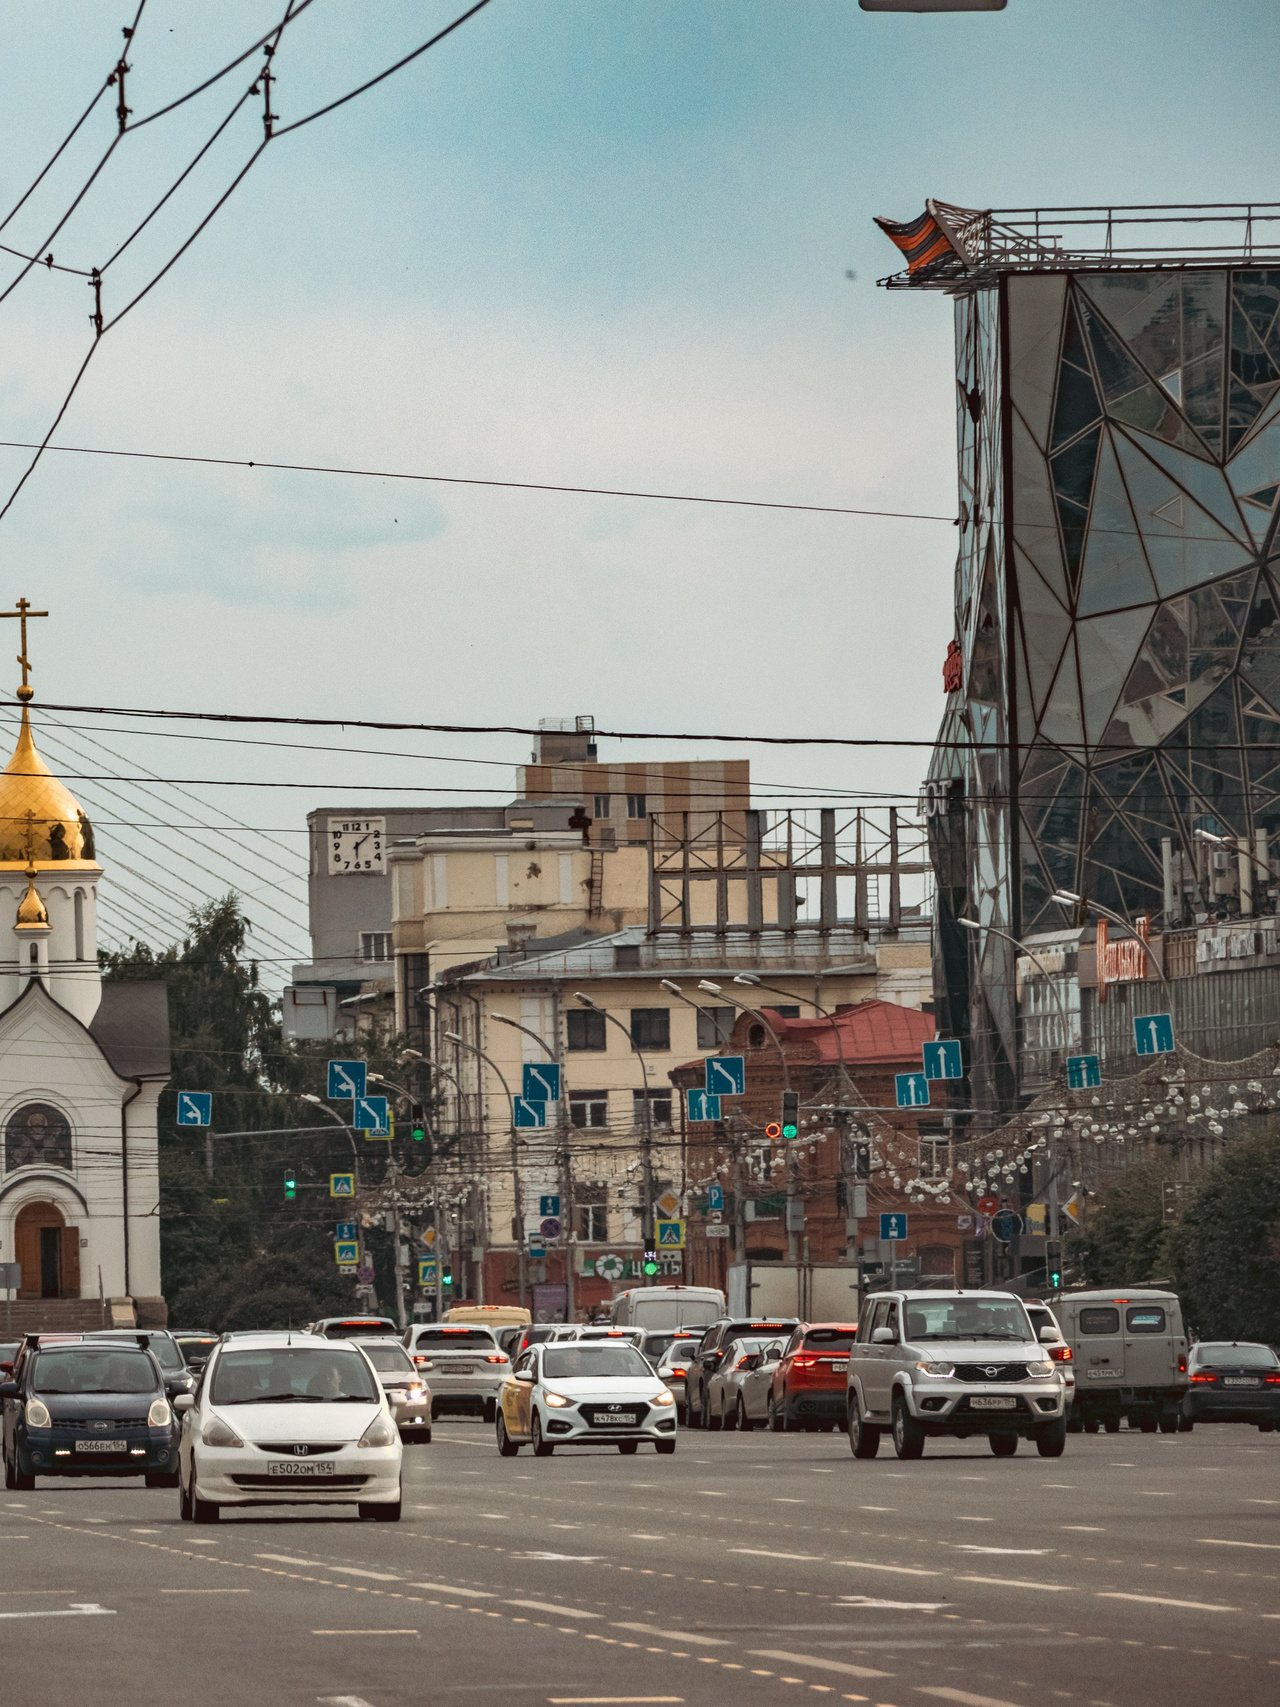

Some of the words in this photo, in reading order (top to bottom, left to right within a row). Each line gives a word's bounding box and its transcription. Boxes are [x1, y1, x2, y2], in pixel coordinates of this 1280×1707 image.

[342, 823, 349, 831] 11
[351, 823, 361, 831] 12
[365, 823, 369, 831] 1
[333, 830, 342, 839] 10
[373, 830, 380, 838] 2
[333, 842, 340, 850] 9
[373, 841, 380, 850] 3
[334, 853, 341, 862] 8
[374, 852, 381, 861] 4
[344, 861, 350, 870] 7
[354, 861, 361, 870] 6
[364, 860, 371, 869] 5
